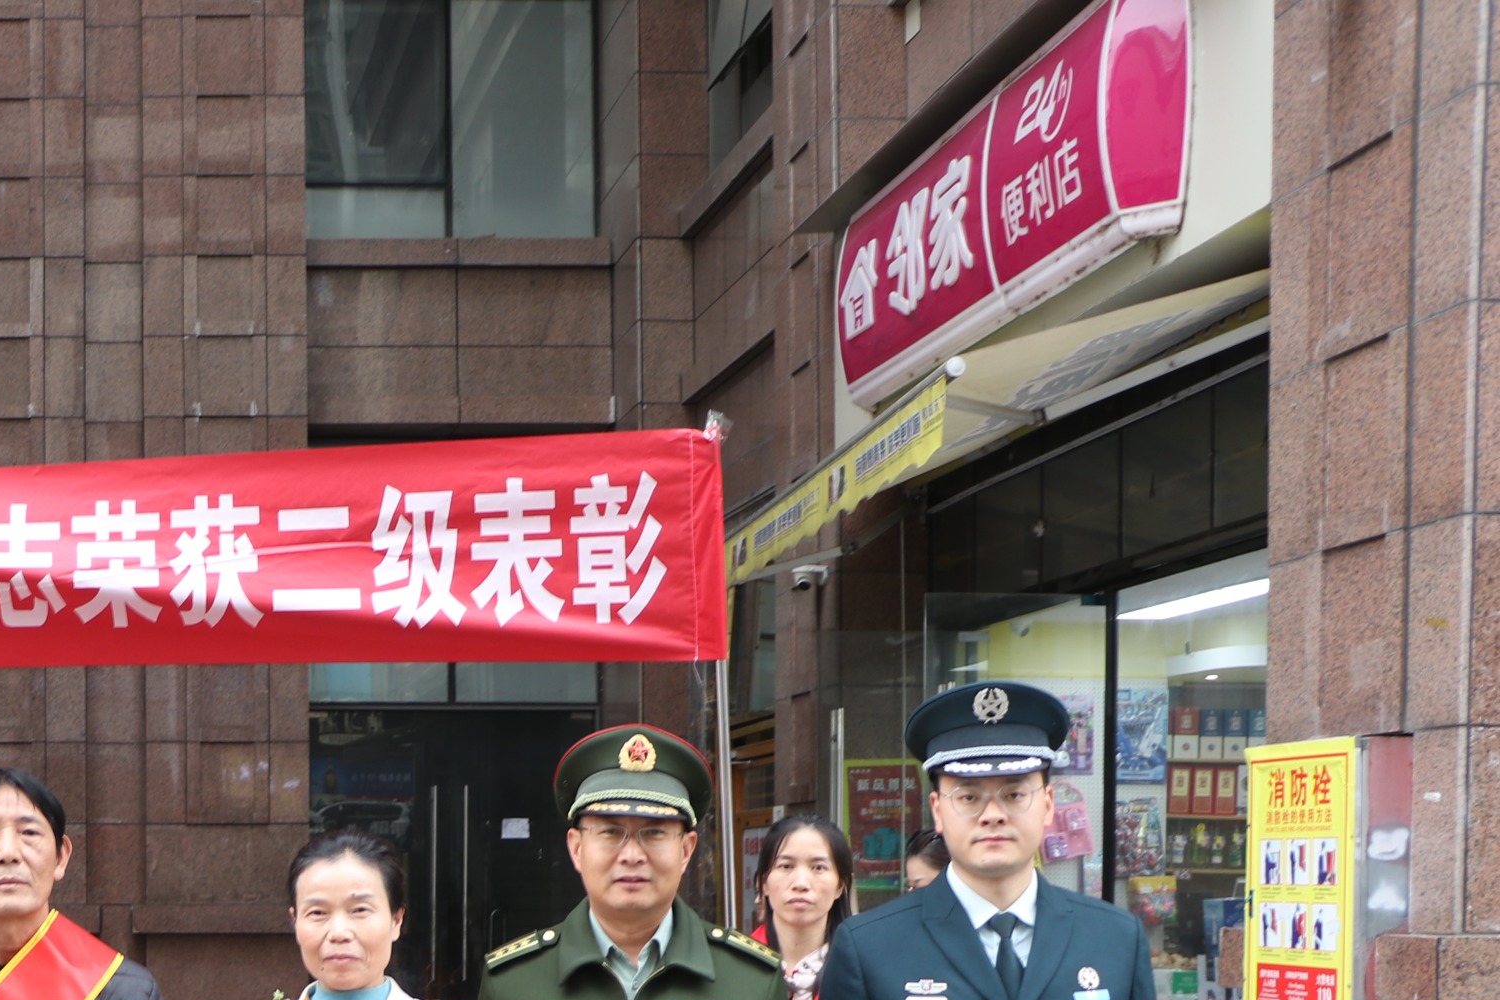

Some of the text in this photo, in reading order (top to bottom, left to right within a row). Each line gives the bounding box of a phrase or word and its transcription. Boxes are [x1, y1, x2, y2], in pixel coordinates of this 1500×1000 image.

[885, 154, 974, 316] 邻家
[1001, 136, 1083, 247] 便利店
[1268, 764, 1332, 809] 消防栓
